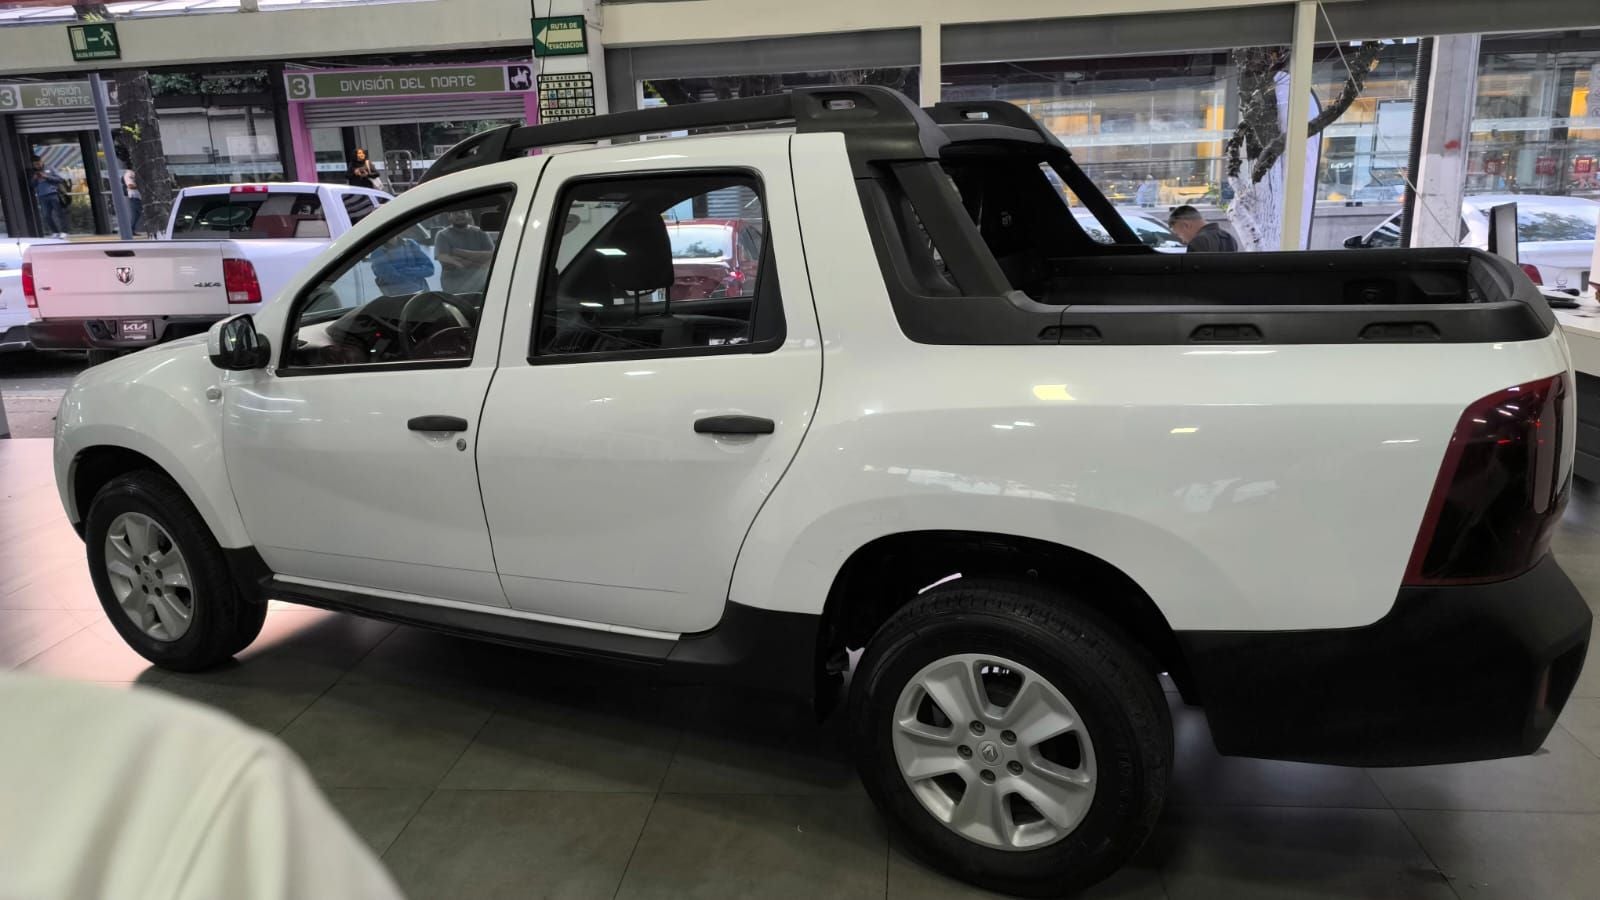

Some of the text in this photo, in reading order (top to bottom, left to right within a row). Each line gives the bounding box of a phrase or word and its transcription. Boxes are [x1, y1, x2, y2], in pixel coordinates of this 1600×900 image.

[340, 75, 476, 92] DIVISIÓN DEL NORTE
[41, 86, 81, 97] DIVISIÓN
[35, 95, 91, 107] DEL NORTE
[123, 323, 148, 331] KIA
